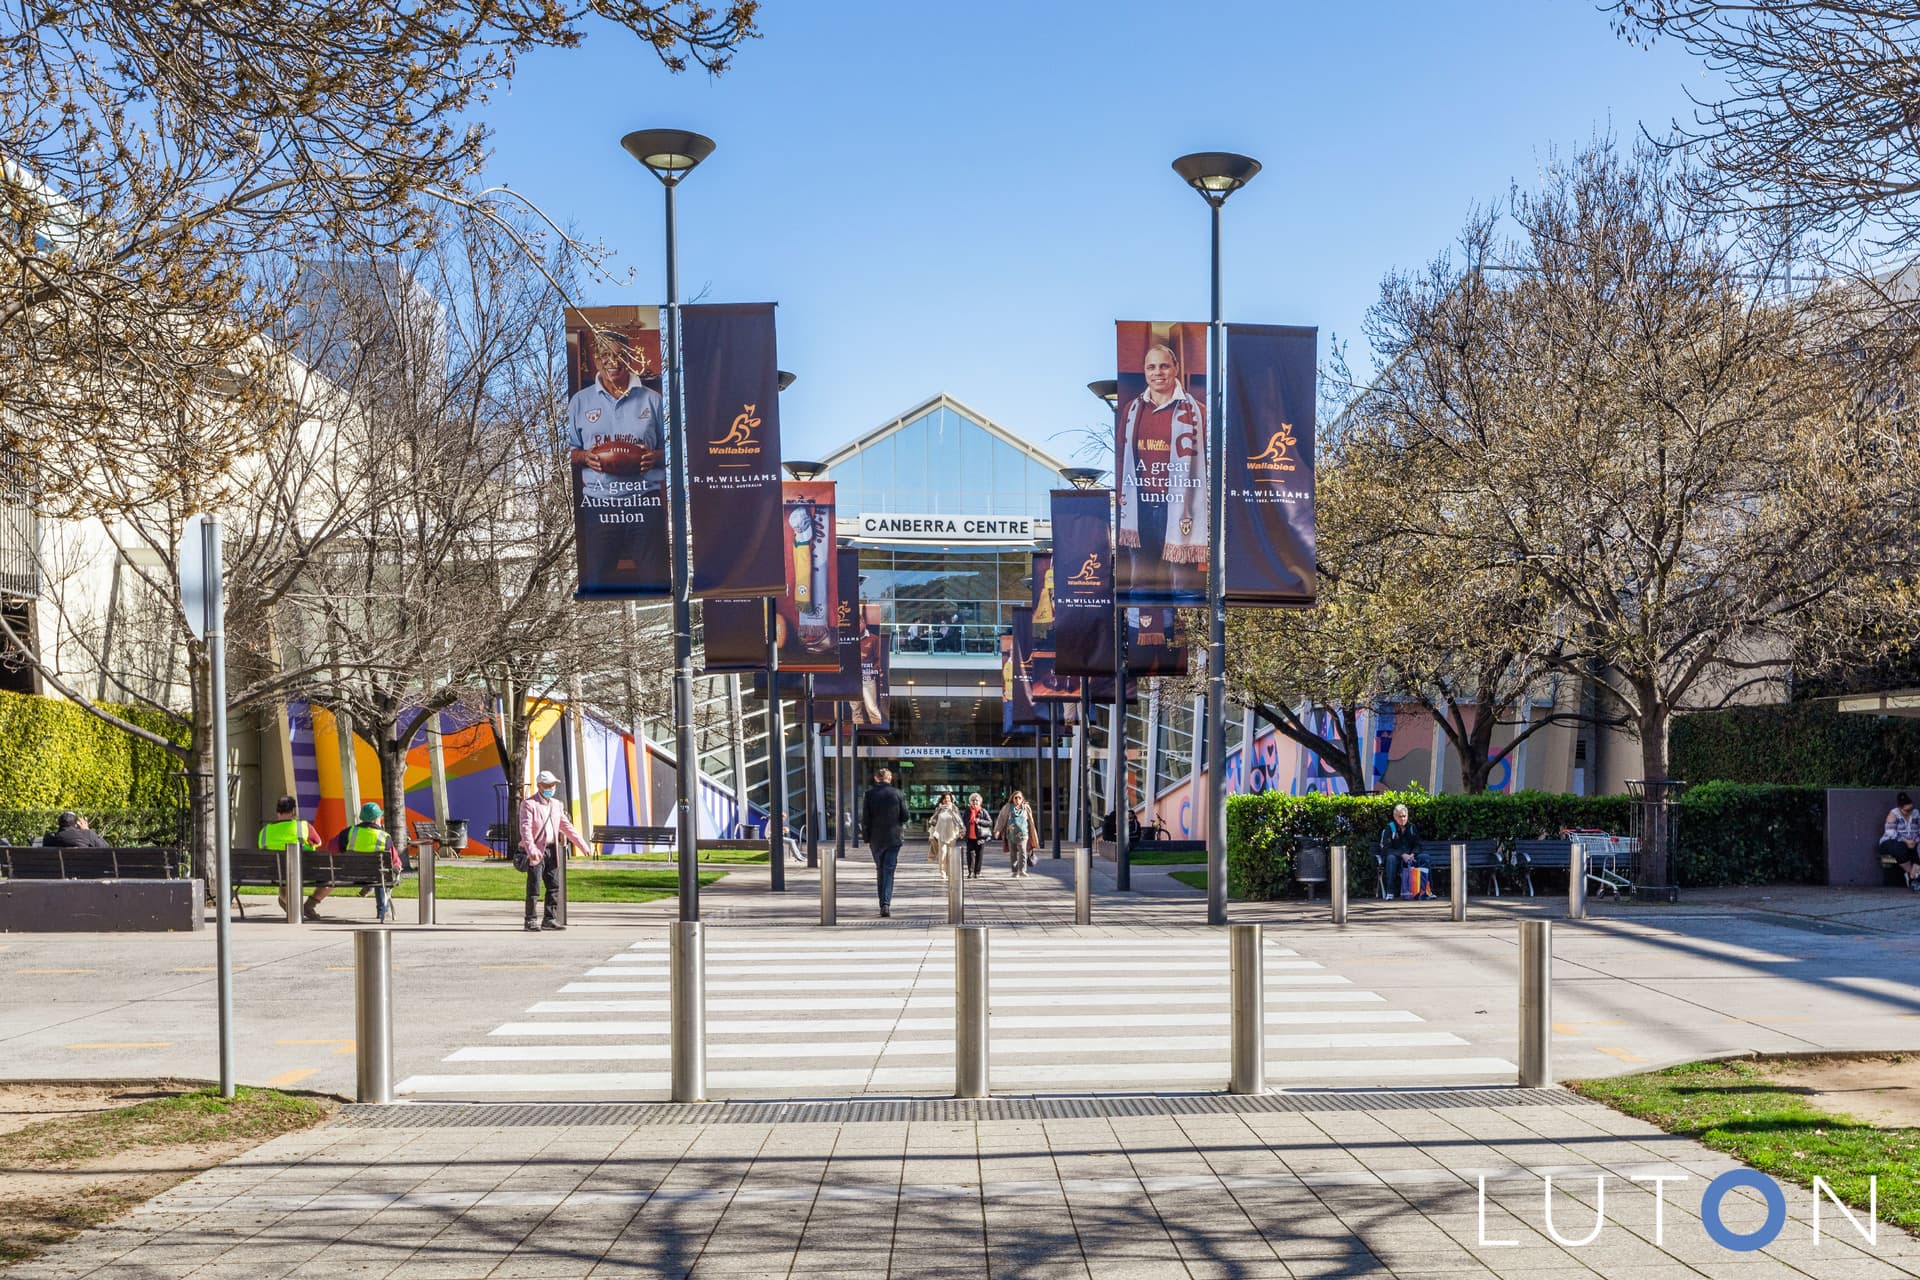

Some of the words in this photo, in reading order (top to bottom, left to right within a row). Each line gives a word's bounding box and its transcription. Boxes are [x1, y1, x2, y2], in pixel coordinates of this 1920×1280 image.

[709, 446, 760, 455] Wallabies
[1135, 458, 1147, 471] A
[1151, 460, 1190, 474] great
[1246, 462, 1296, 472] Wallabies
[593, 480, 604, 491] A
[609, 480, 648, 494] great
[1123, 473, 1202, 487] Australian
[580, 493, 661, 508] Australian
[1140, 489, 1184, 503] union
[599, 510, 645, 523] union
[865, 518, 957, 533] CANBERRA
[963, 520, 1029, 534] CENTRE
[904, 747, 952, 755] CANBERRA
[955, 748, 991, 756] CENTRE
